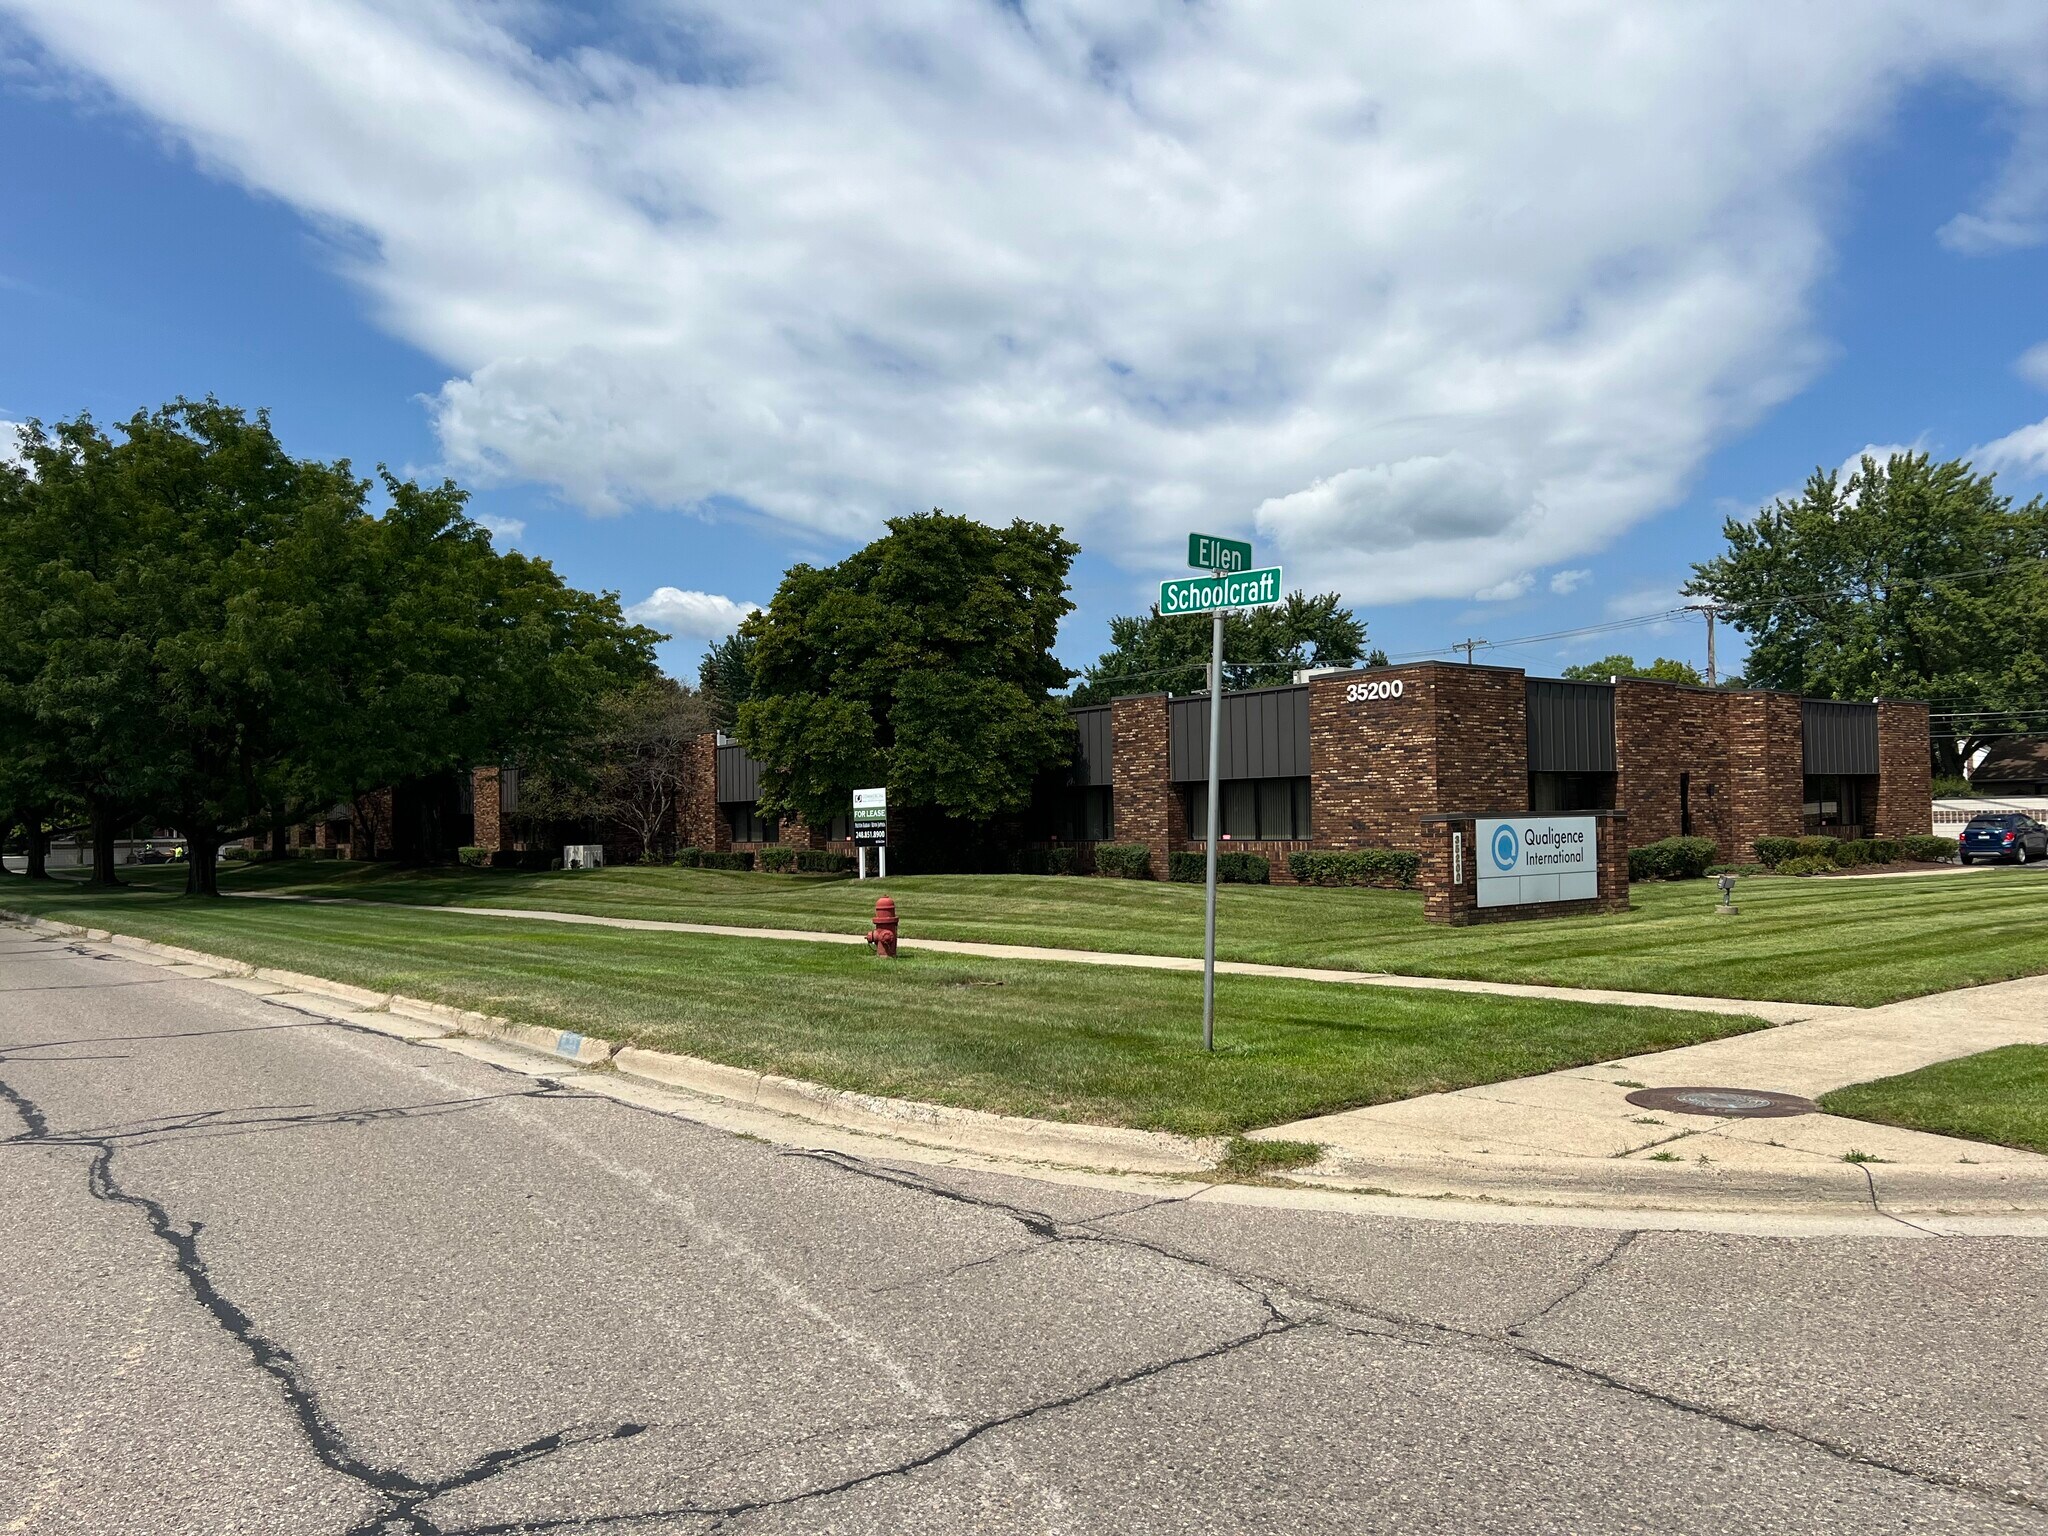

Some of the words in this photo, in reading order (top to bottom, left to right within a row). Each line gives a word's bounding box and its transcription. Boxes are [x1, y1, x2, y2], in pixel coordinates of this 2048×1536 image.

[1199, 538, 1241, 570] Ellen
[1167, 572, 1274, 610] Schoolcraft
[1346, 679, 1403, 702] 35200
[854, 810, 866, 818] FOR
[866, 809, 885, 817] LEASE
[1524, 826, 1584, 849] Qualigence
[1525, 847, 1584, 866] International
